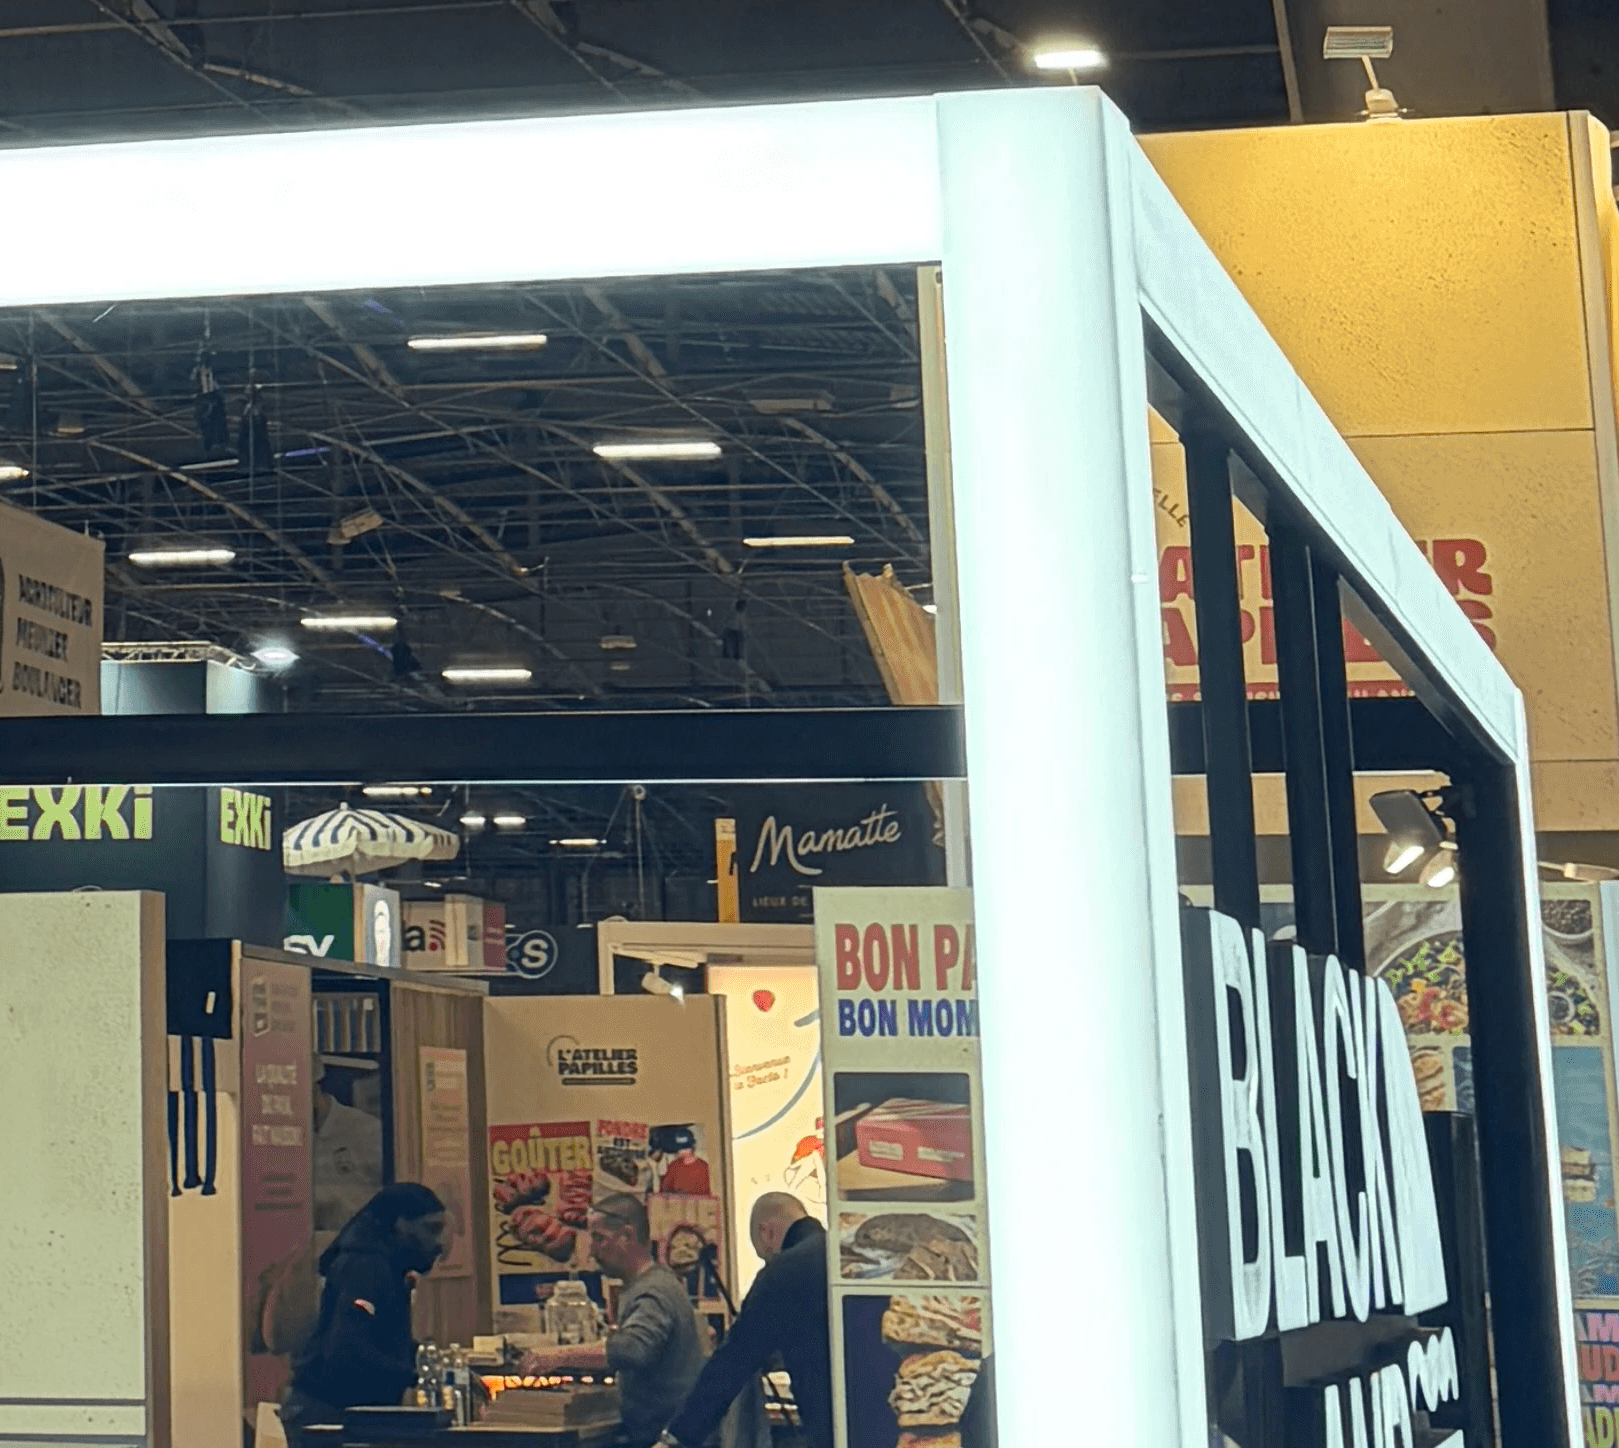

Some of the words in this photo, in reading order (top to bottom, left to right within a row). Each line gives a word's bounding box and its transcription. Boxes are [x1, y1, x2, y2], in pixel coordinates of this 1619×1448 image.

[749, 803, 902, 876] Mamatte
[835, 922, 921, 992] BON
[837, 998, 899, 1037] BON
[492, 1125, 593, 1175] GOÛTER
[1209, 908, 1405, 1343] BLACK
